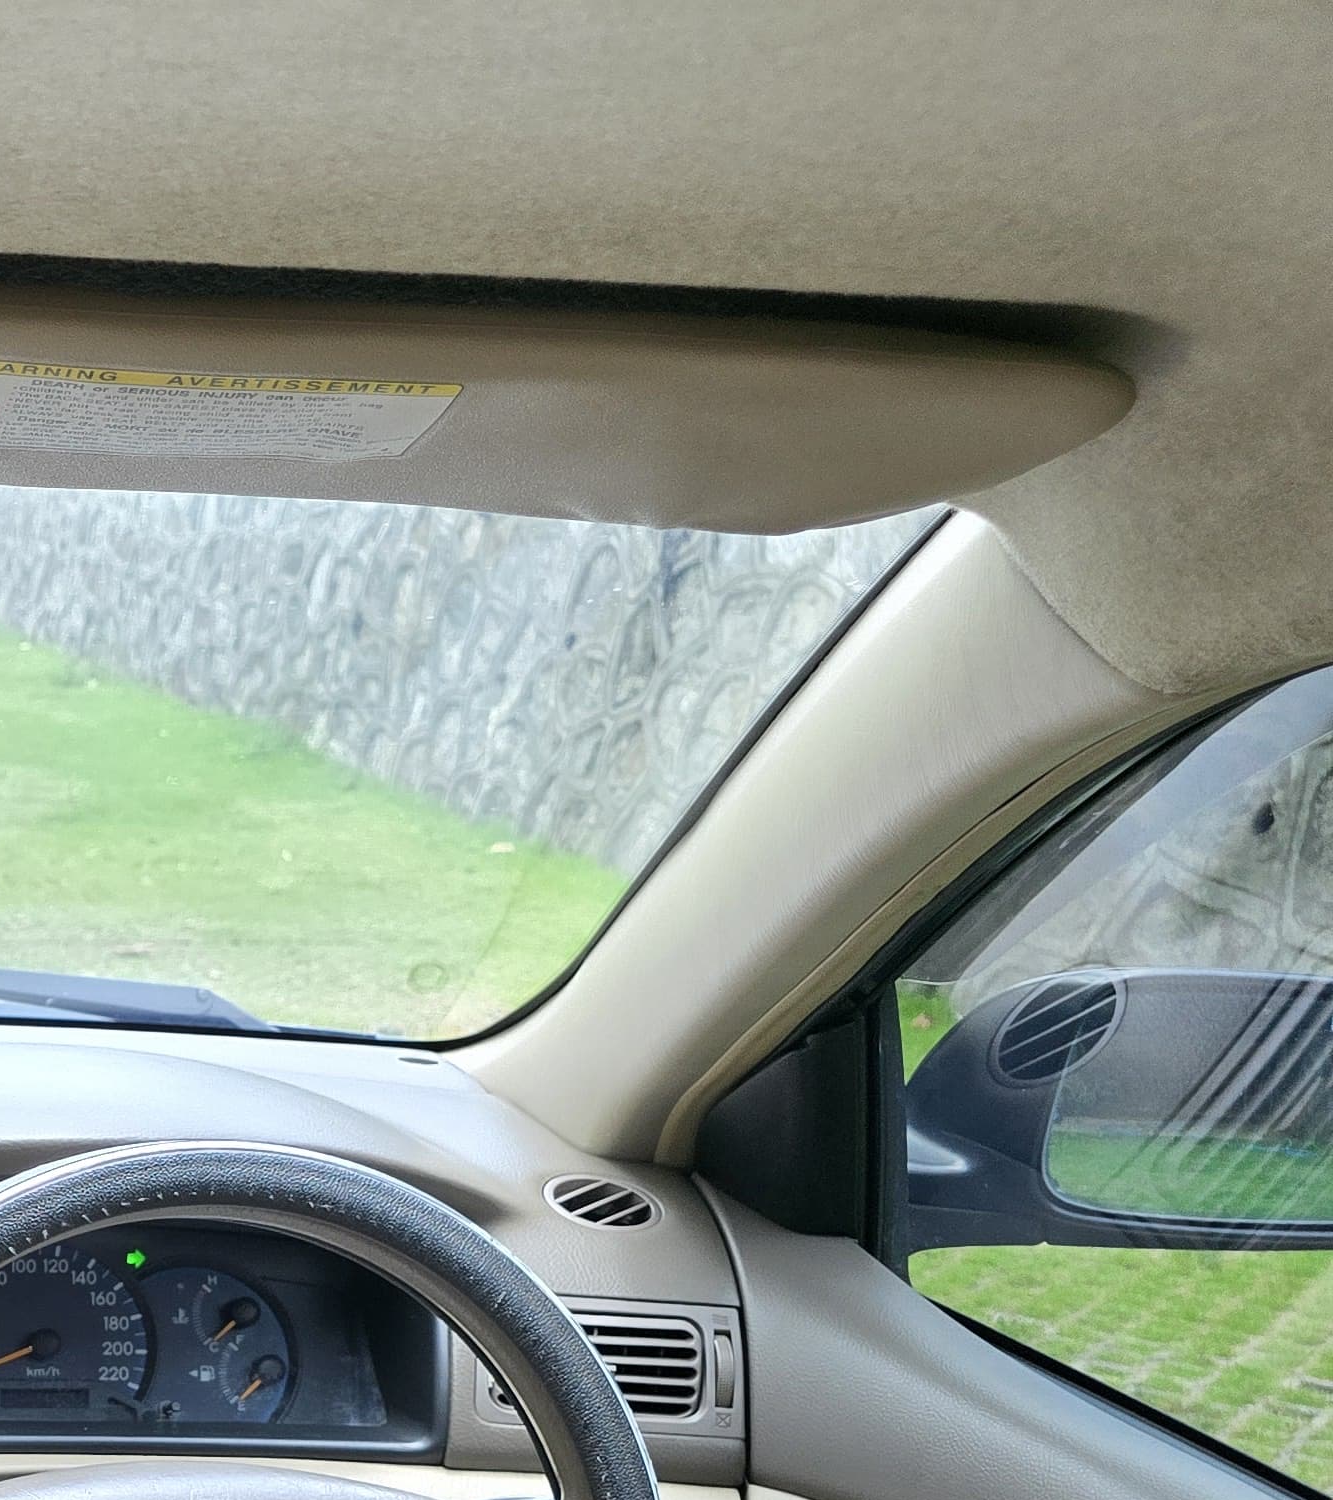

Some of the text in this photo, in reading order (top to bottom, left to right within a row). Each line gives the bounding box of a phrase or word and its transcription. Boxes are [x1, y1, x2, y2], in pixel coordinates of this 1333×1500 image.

[31, 379, 85, 390] DEATH
[117, 387, 191, 397] SERIOUS
[198, 391, 258, 400] INJURY
[166, 375, 439, 394] AVERTISSEMENT
[12, 1259, 37, 1274] 100
[43, 1259, 69, 1274] 120
[71, 1270, 97, 1285] 140
[207, 1275, 218, 1286] H
[90, 1291, 117, 1306] 160
[103, 1316, 130, 1331] 180
[236, 1334, 245, 1345] F
[102, 1342, 134, 1356] 200
[26, 1366, 61, 1377] km/h
[98, 1366, 130, 1381] 220
